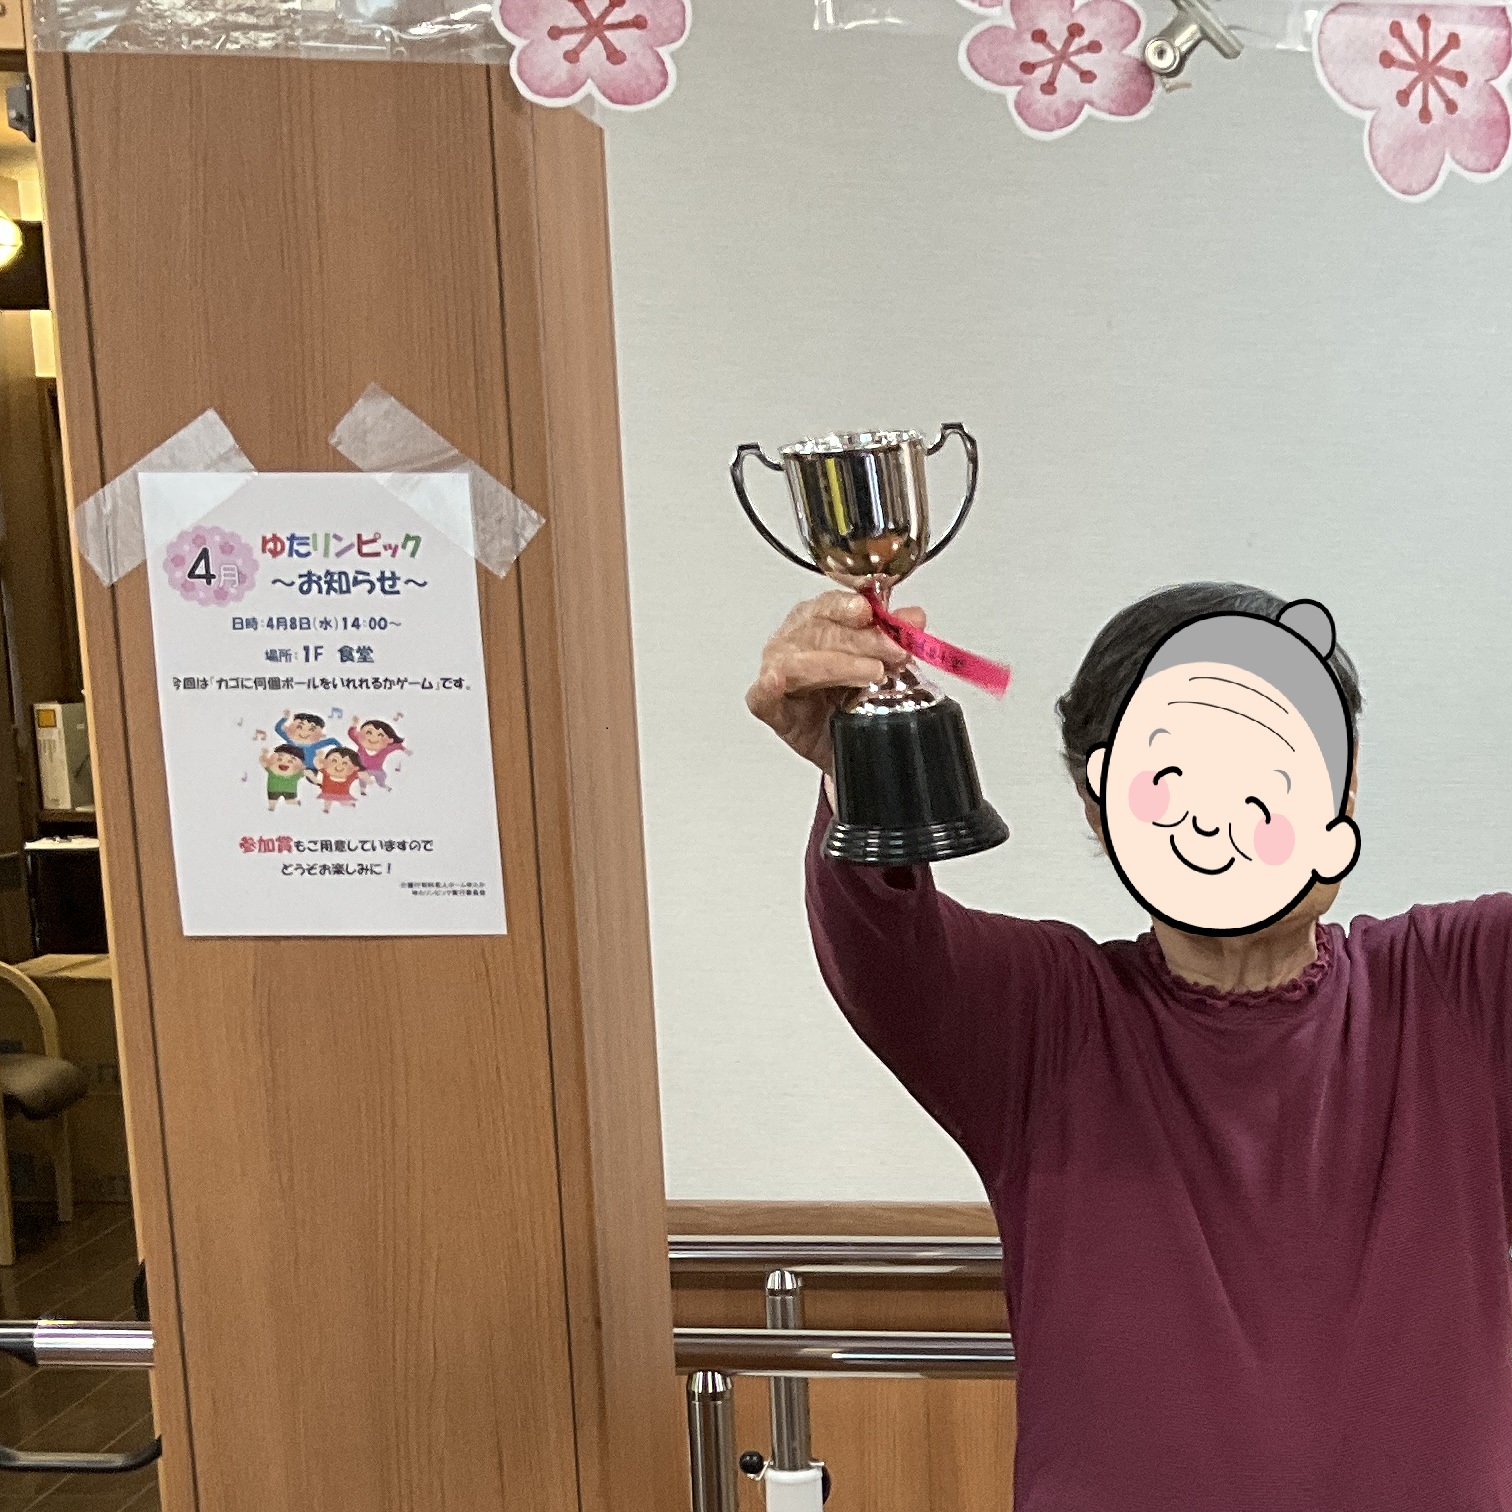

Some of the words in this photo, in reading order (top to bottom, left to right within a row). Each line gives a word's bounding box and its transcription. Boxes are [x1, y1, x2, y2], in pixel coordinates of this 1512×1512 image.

[260, 532, 422, 558] ゆたリンピック
[337, 645, 375, 663] 食堂
